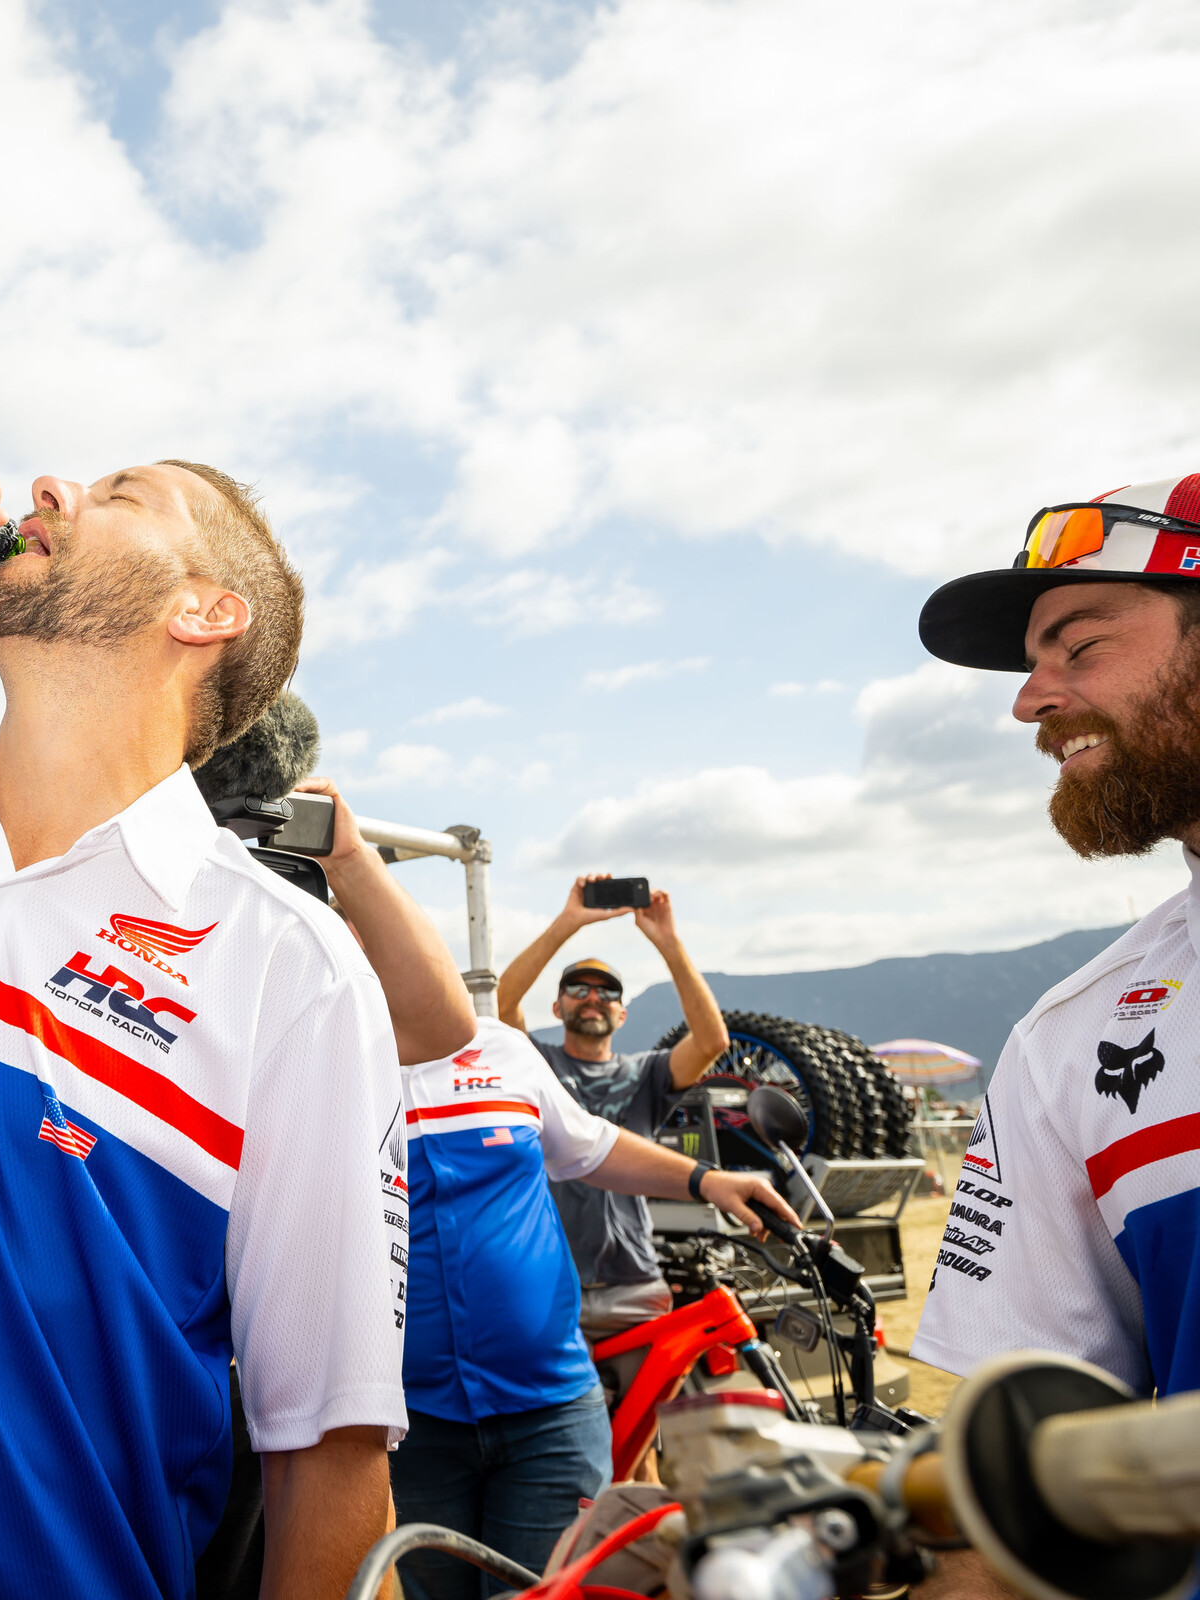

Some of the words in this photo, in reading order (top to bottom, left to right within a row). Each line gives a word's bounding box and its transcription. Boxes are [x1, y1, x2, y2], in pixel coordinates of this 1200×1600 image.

[1137, 513, 1171, 525] 100%
[95, 927, 190, 987] HONDA
[44, 981, 103, 1018] Honda
[106, 1014, 171, 1055] RACING
[49, 950, 198, 1045] HRC
[454, 1076, 502, 1091] HRC
